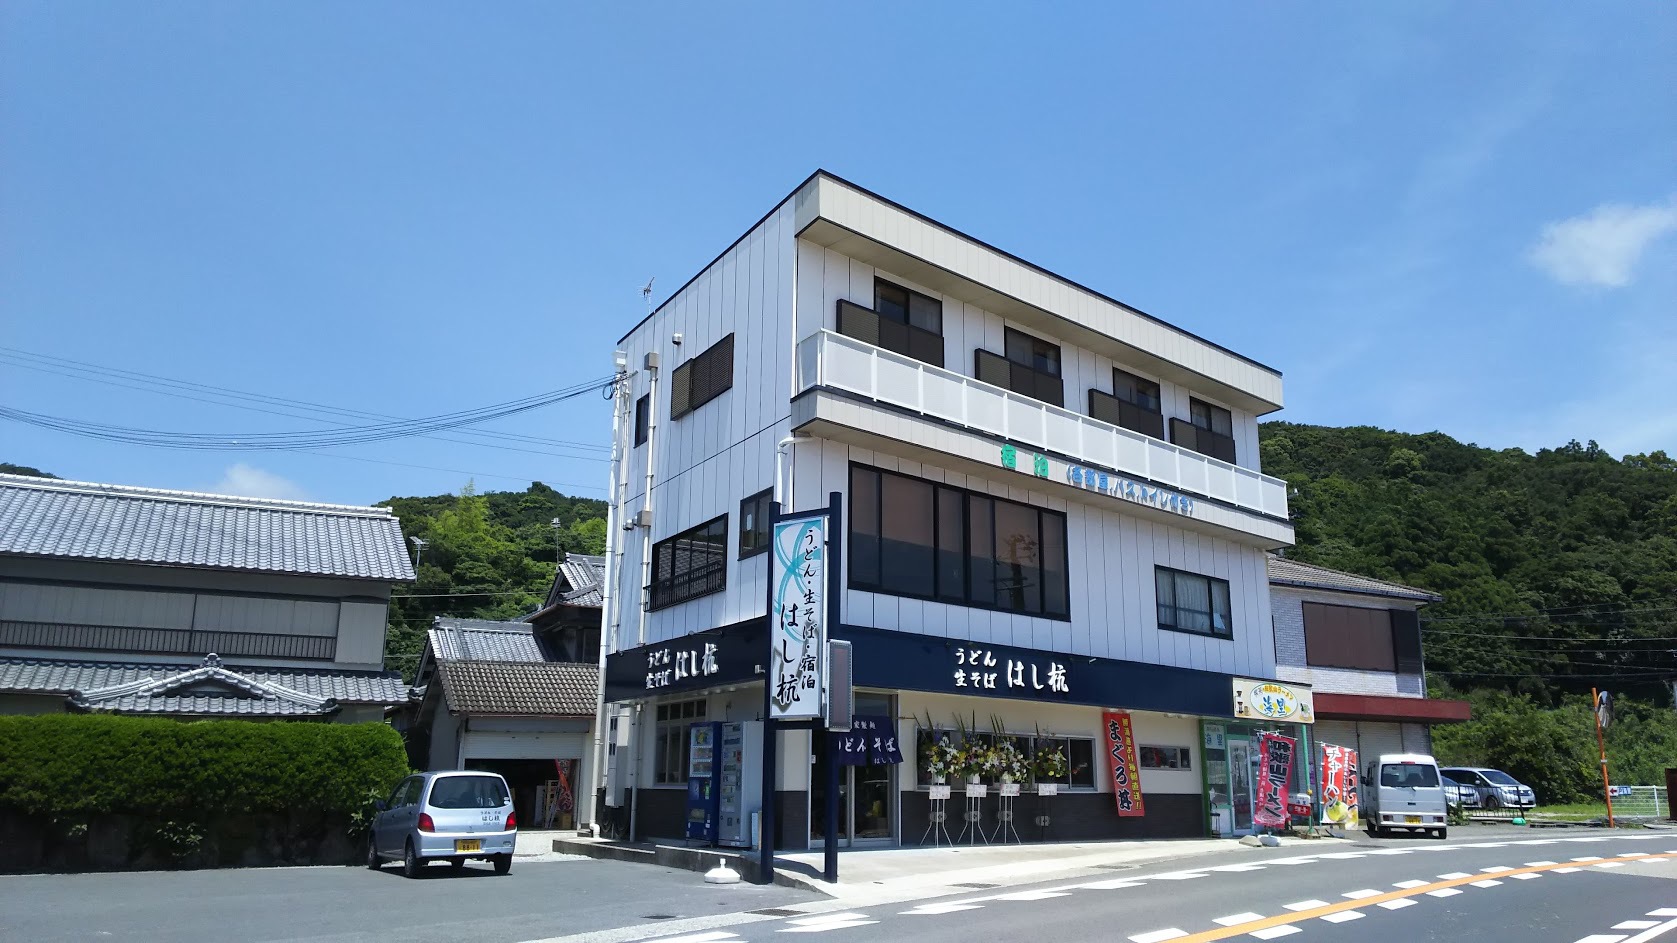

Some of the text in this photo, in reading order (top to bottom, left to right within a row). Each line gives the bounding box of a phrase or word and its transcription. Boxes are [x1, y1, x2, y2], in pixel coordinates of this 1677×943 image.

[800, 529, 818, 690] うどん・生そば・宿泊
[647, 649, 670, 669] うどん
[675, 643, 719, 681] はし杭
[776, 602, 801, 705] はし杭
[956, 648, 997, 667] うどん
[646, 669, 672, 689] 生そば
[954, 669, 998, 689] 生そば
[1007, 659, 1069, 693] はし杭
[1108, 719, 1133, 812] まぐろ丼
[1324, 747, 1343, 808] チャーハン
